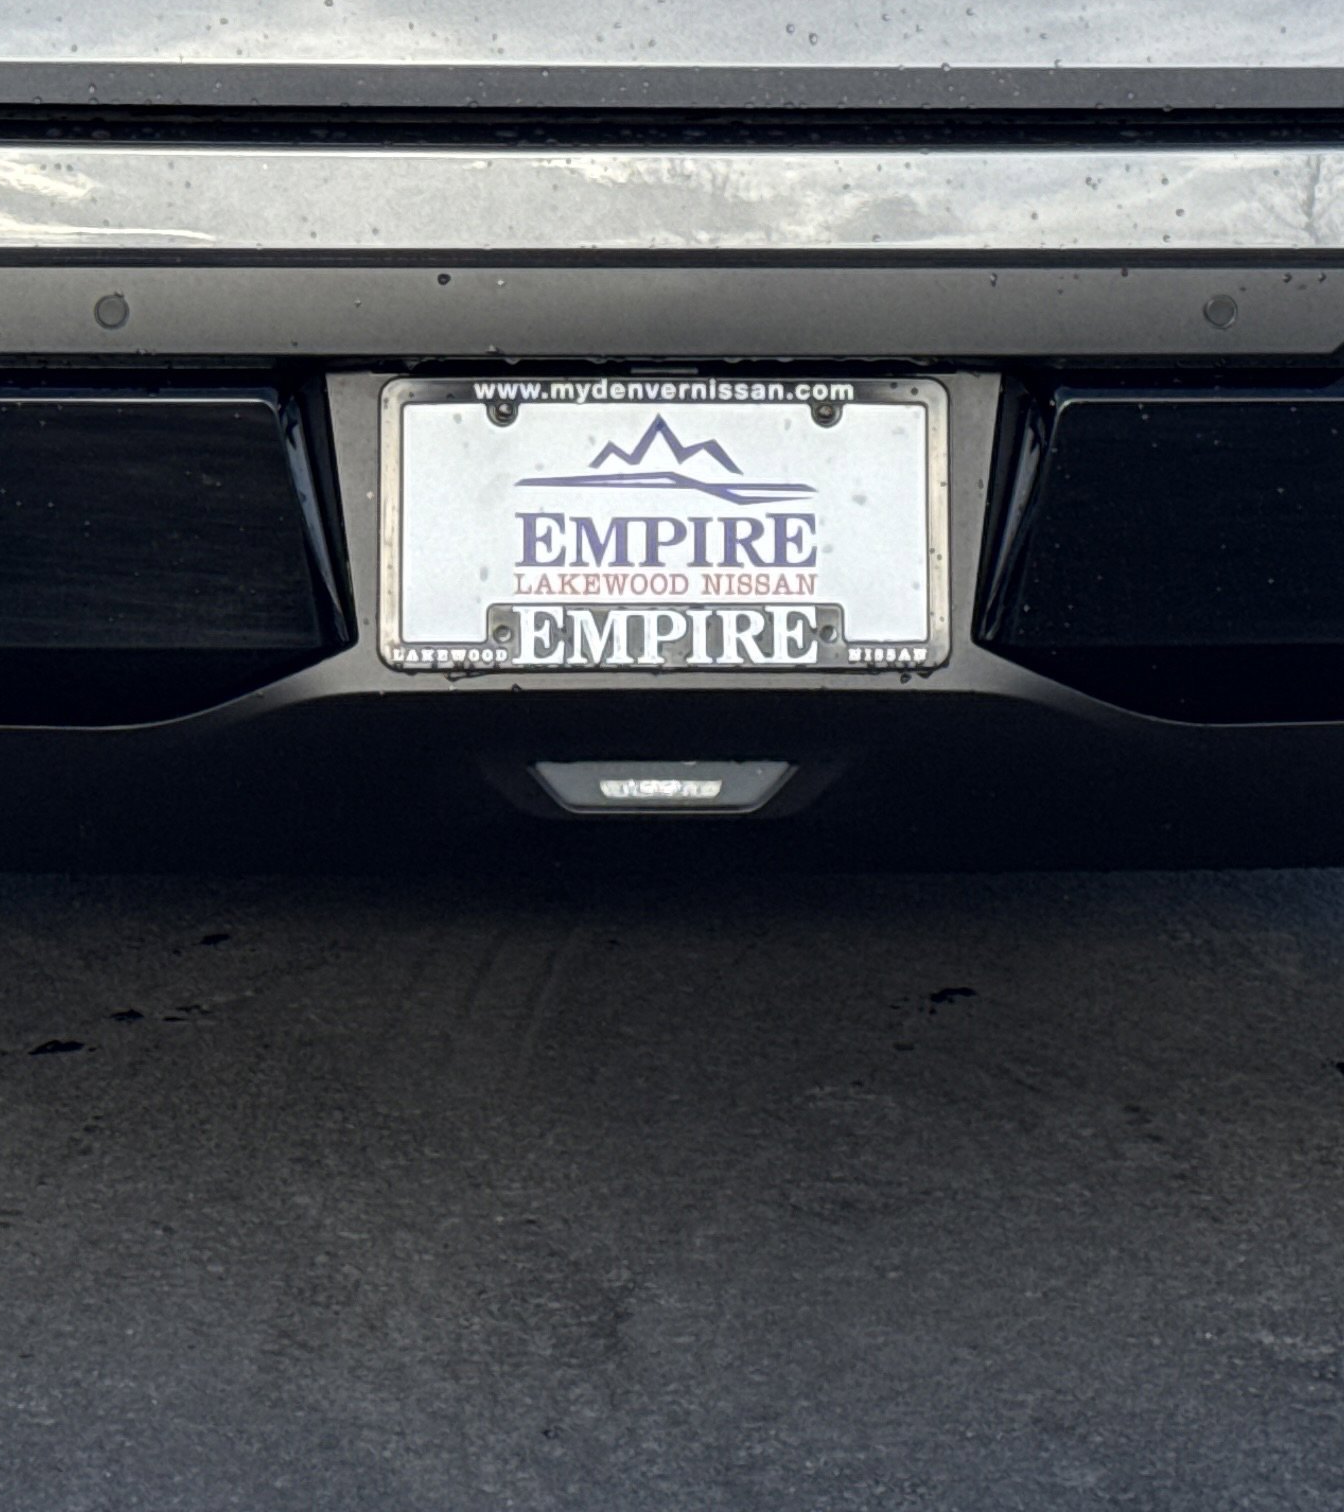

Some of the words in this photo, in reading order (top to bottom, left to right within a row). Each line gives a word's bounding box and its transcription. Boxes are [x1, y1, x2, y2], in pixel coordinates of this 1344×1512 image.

[474, 379, 854, 404] www.mydenvernissan.com
[515, 512, 816, 567] EMPIRE
[515, 574, 689, 595] LAKEWOOD
[701, 574, 816, 596] NISSAN
[393, 648, 508, 663] LAKEWOOD
[512, 605, 817, 665] EMPIRE
[848, 647, 927, 662] NISSAN
